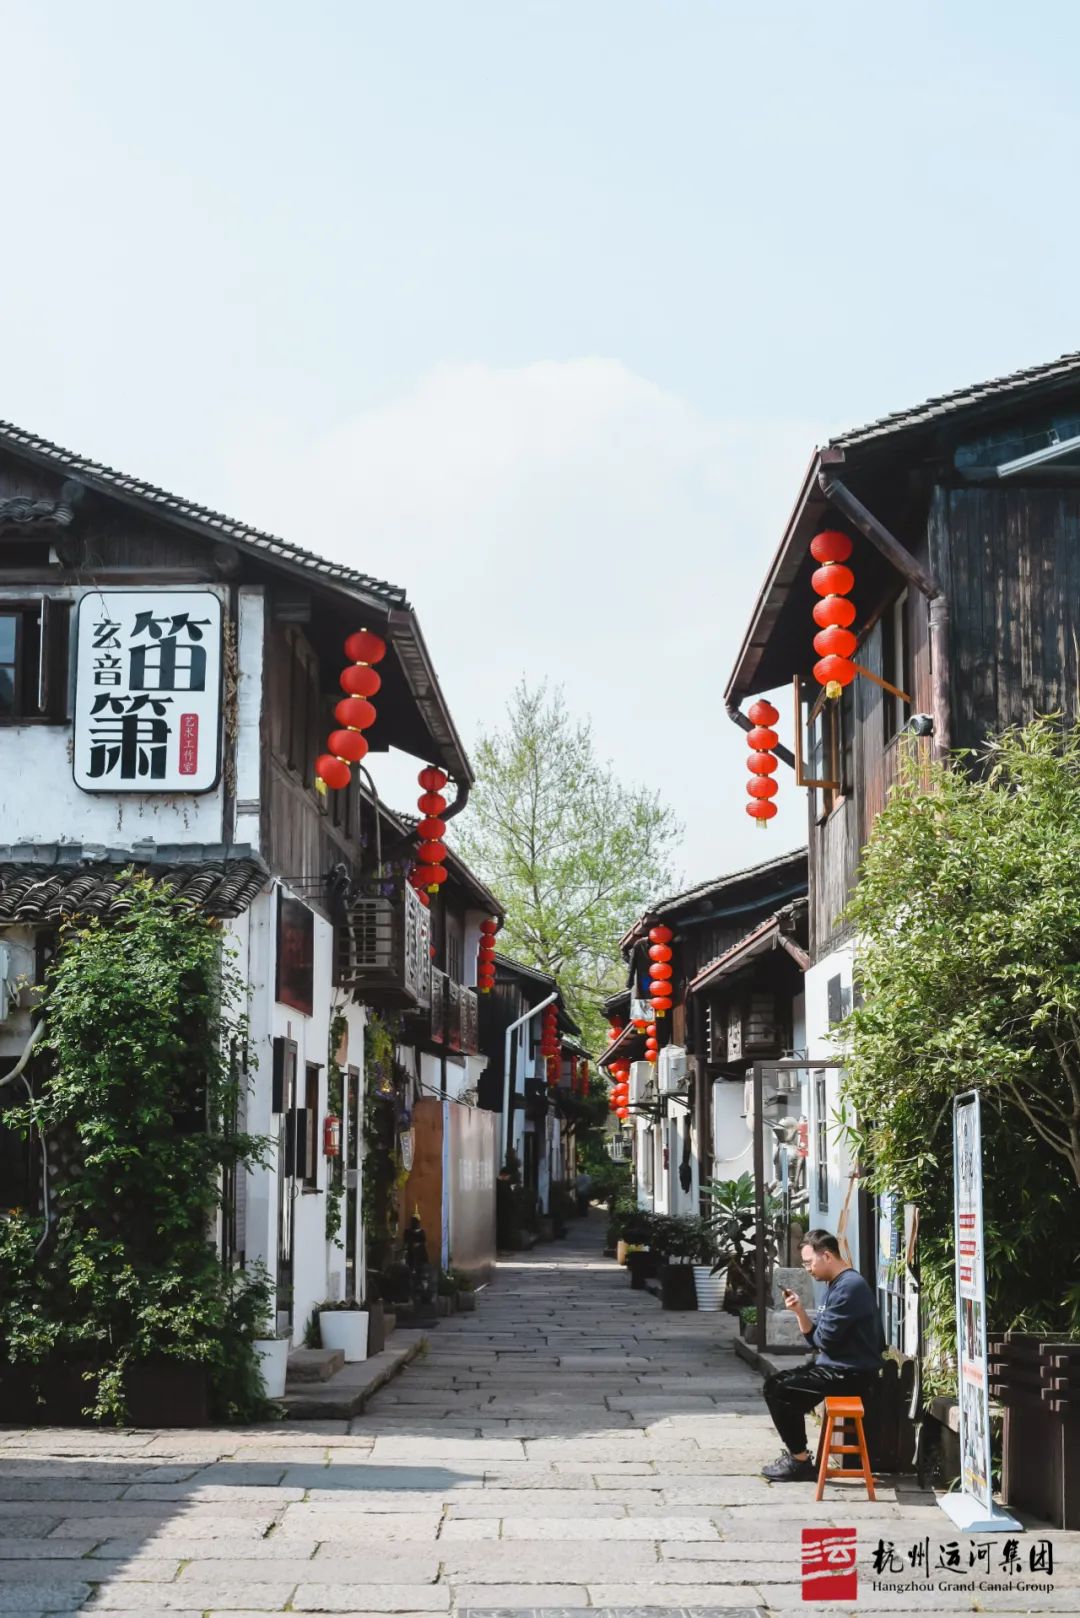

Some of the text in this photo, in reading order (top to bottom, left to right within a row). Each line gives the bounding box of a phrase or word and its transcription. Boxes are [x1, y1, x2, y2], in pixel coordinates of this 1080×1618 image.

[92, 618, 122, 685] 玄音
[128, 610, 212, 692] 笛
[183, 715, 196, 773] 艺术工作室
